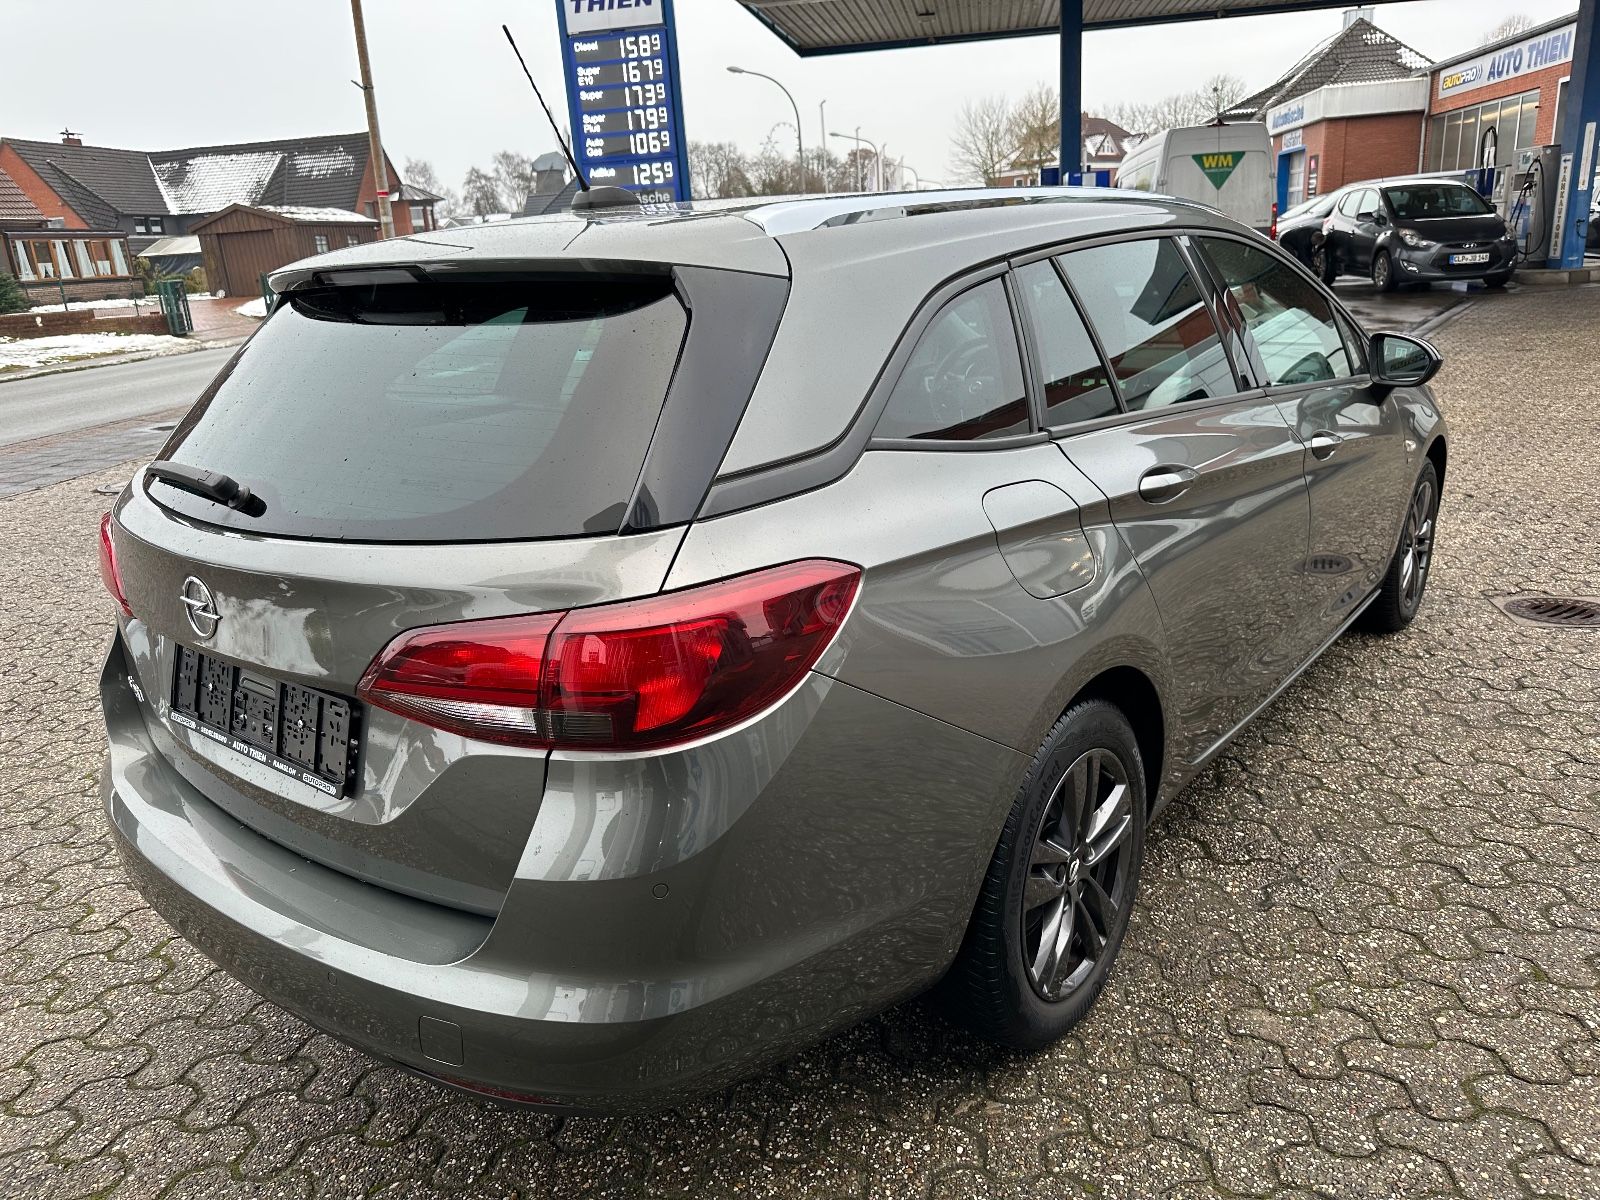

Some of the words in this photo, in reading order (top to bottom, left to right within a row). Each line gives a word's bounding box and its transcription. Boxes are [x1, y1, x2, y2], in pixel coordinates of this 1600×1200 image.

[574, 41, 598, 52] Diesel
[620, 34, 661, 58] 1589
[1487, 48, 1523, 81] AUTO
[1527, 31, 1572, 69] THIEN
[577, 66, 600, 77] Super
[622, 59, 663, 82] 1679
[578, 75, 594, 86] E10
[580, 90, 603, 101] Super
[625, 83, 665, 107] 1739
[583, 114, 606, 124] Super
[627, 107, 668, 130] 1799
[584, 123, 601, 133] Plus
[586, 138, 604, 147] Auto
[630, 131, 670, 154] 1069
[586, 147, 603, 157] Gas
[1202, 154, 1233, 168] WM
[633, 161, 674, 185] 1259
[1551, 166, 1568, 255] TANKAUTOMAT
[232, 740, 248, 754] AUTO
[249, 747, 267, 762] THIEN
